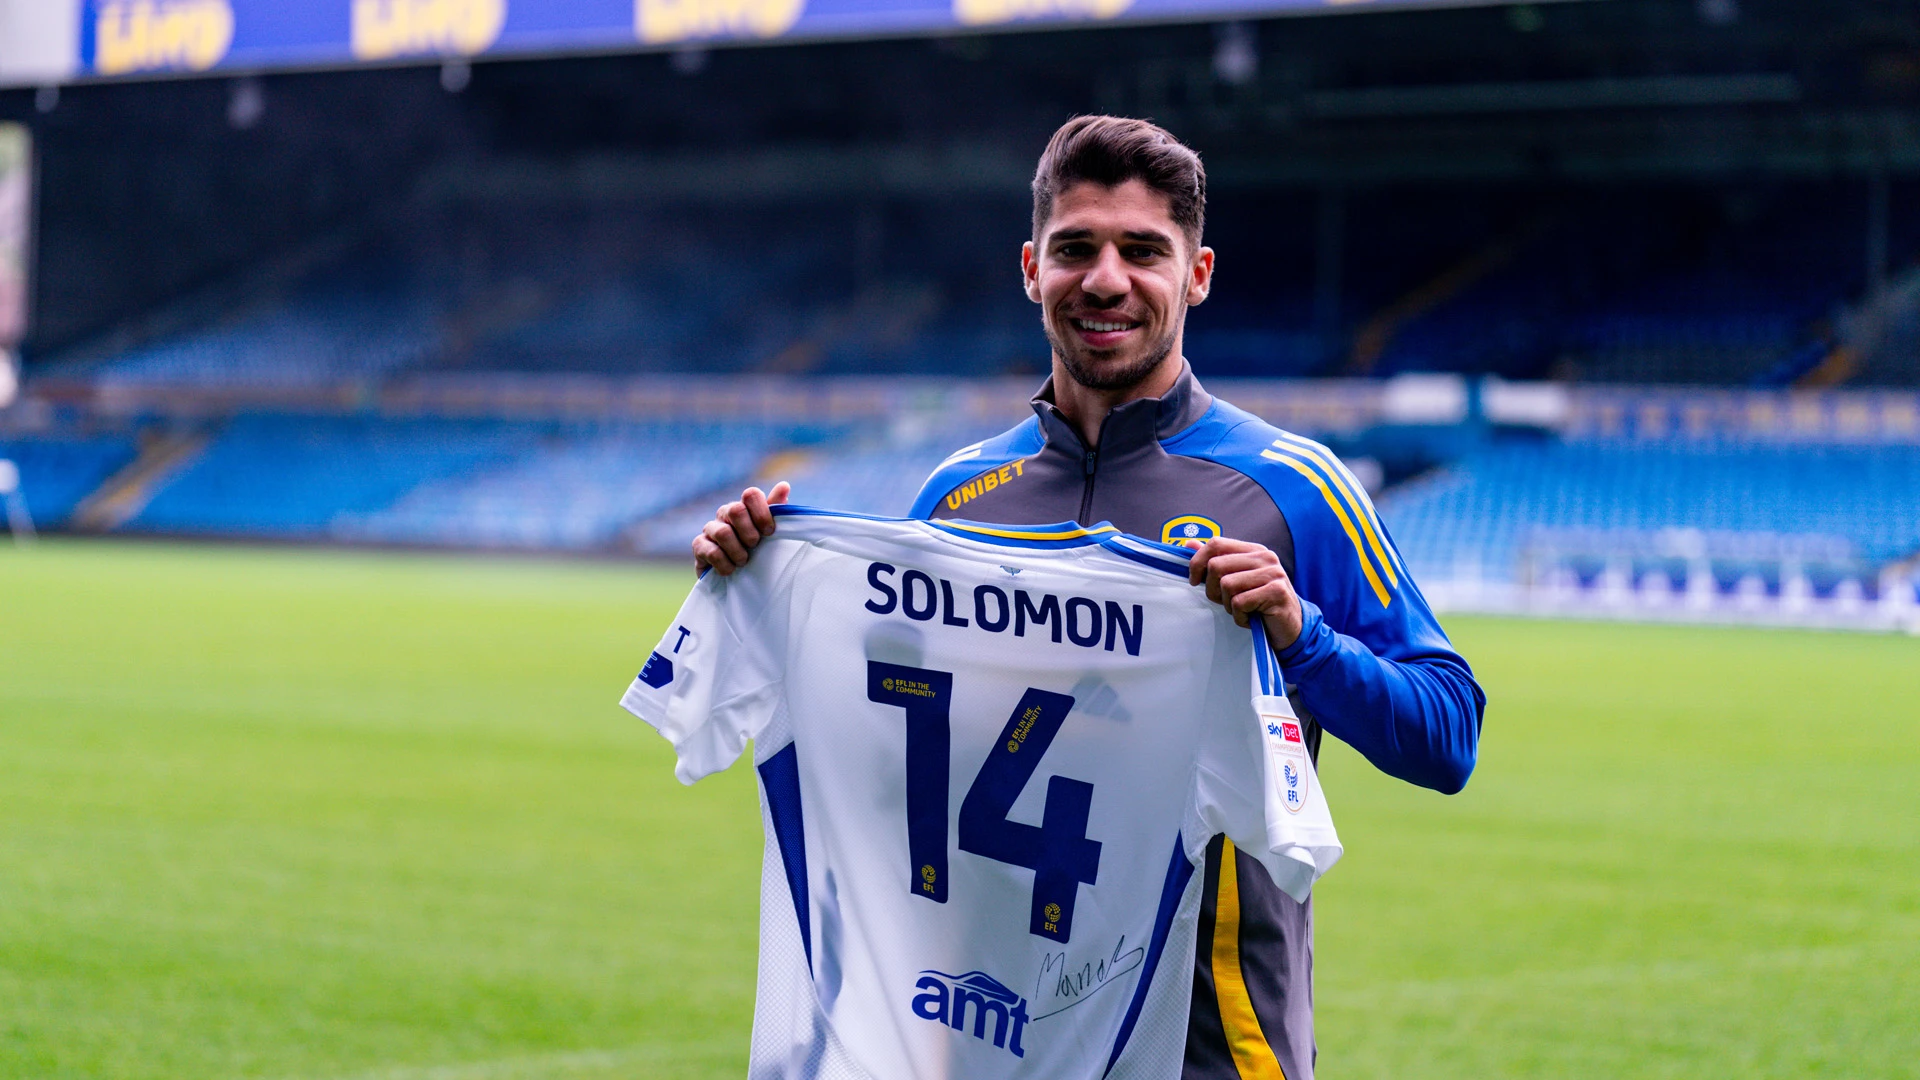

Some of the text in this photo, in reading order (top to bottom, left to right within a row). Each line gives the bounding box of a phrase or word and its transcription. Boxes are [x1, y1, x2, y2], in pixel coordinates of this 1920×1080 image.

[946, 459, 1025, 510] UNIBET
[864, 561, 1144, 657] SOLOMON
[895, 679, 907, 687] EFL
[917, 682, 930, 690] THE
[895, 686, 936, 698] COMMUNITY
[1011, 707, 1033, 740] EFL IN THE
[1017, 705, 1042, 743] COMMUNITY
[1267, 722, 1299, 739] sky bet
[867, 660, 1103, 945] 14
[1287, 789, 1299, 802] EFL
[923, 882, 935, 893] EFL
[1044, 921, 1058, 933] EFL
[911, 976, 1030, 1059] amt
